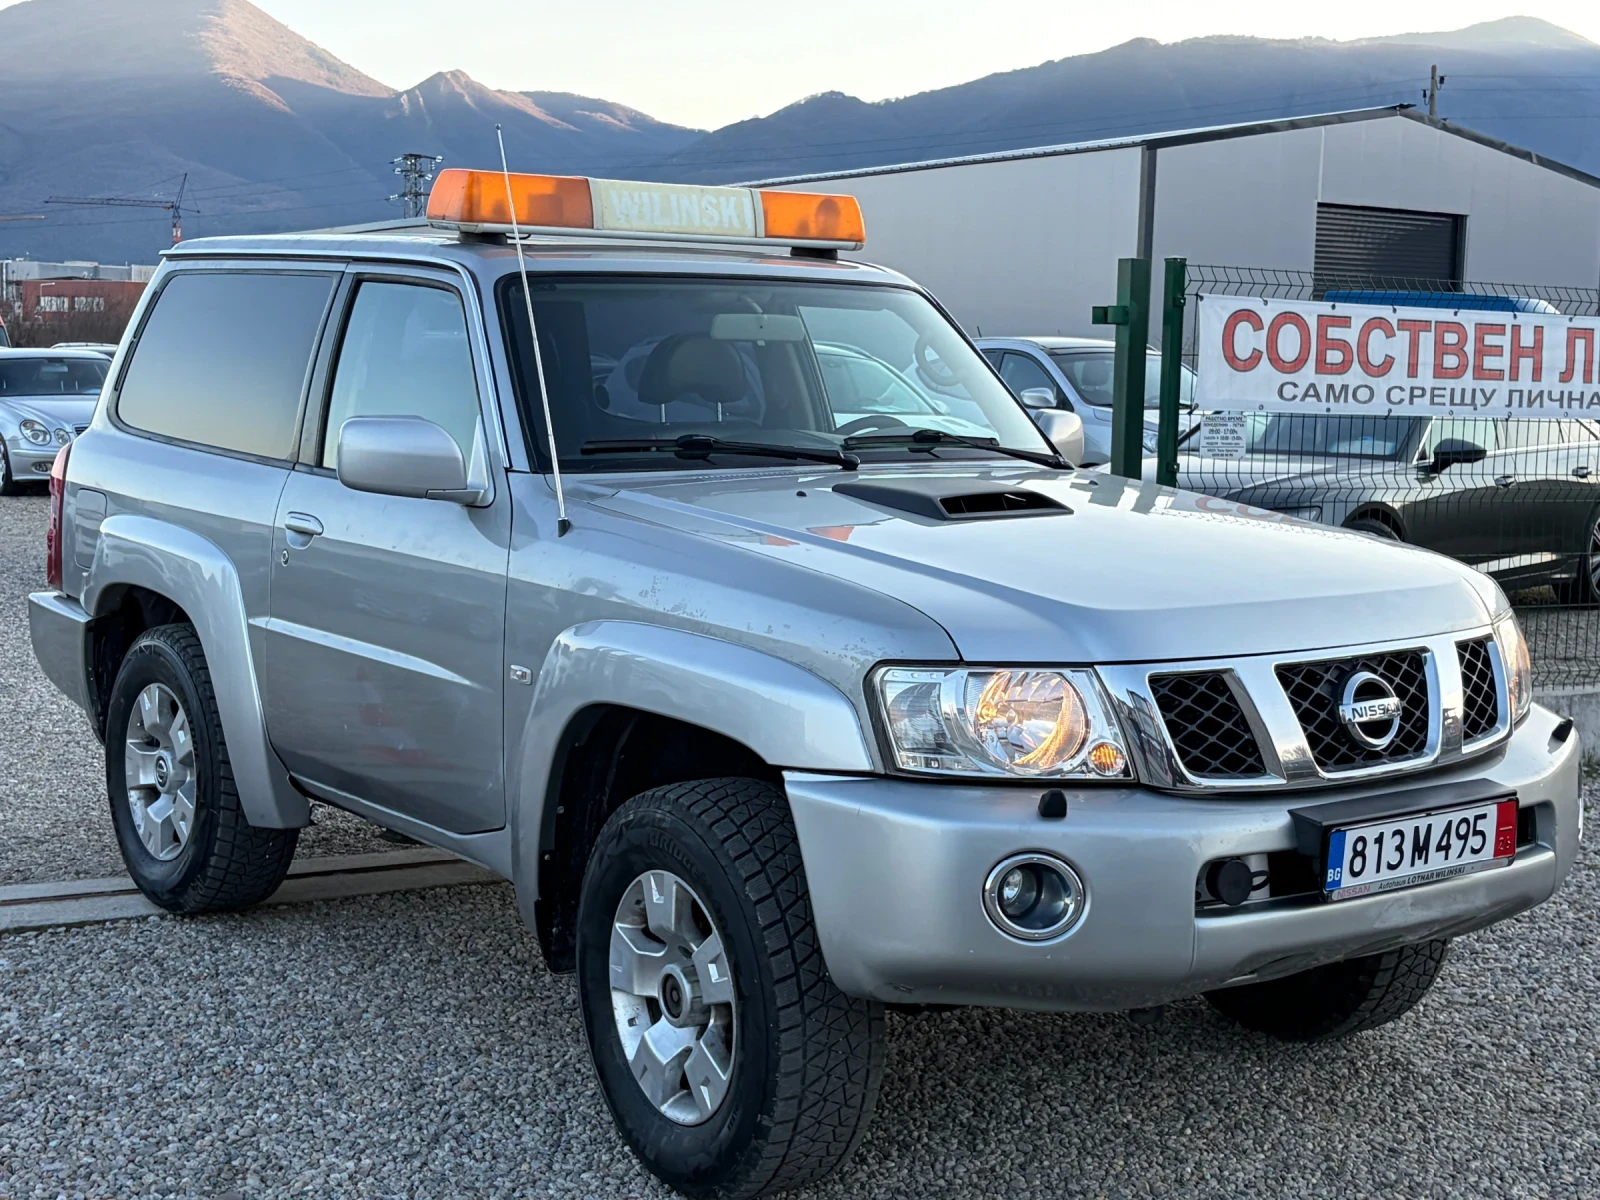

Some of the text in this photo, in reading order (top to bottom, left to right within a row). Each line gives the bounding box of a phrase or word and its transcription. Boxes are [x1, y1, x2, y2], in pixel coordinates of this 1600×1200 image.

[609, 190, 752, 230] WILINSKI
[1221, 308, 1600, 384] СОБСТВЕН Л
[1276, 381, 1600, 411] САМО СРЕЩУ ЛИЧНА
[1351, 703, 1400, 719] NISSAN
[1349, 812, 1488, 878] 813M495
[1327, 867, 1341, 882] BG
[1337, 866, 1466, 899] NISSAN Autohaus LOTHAR WILINSKI
